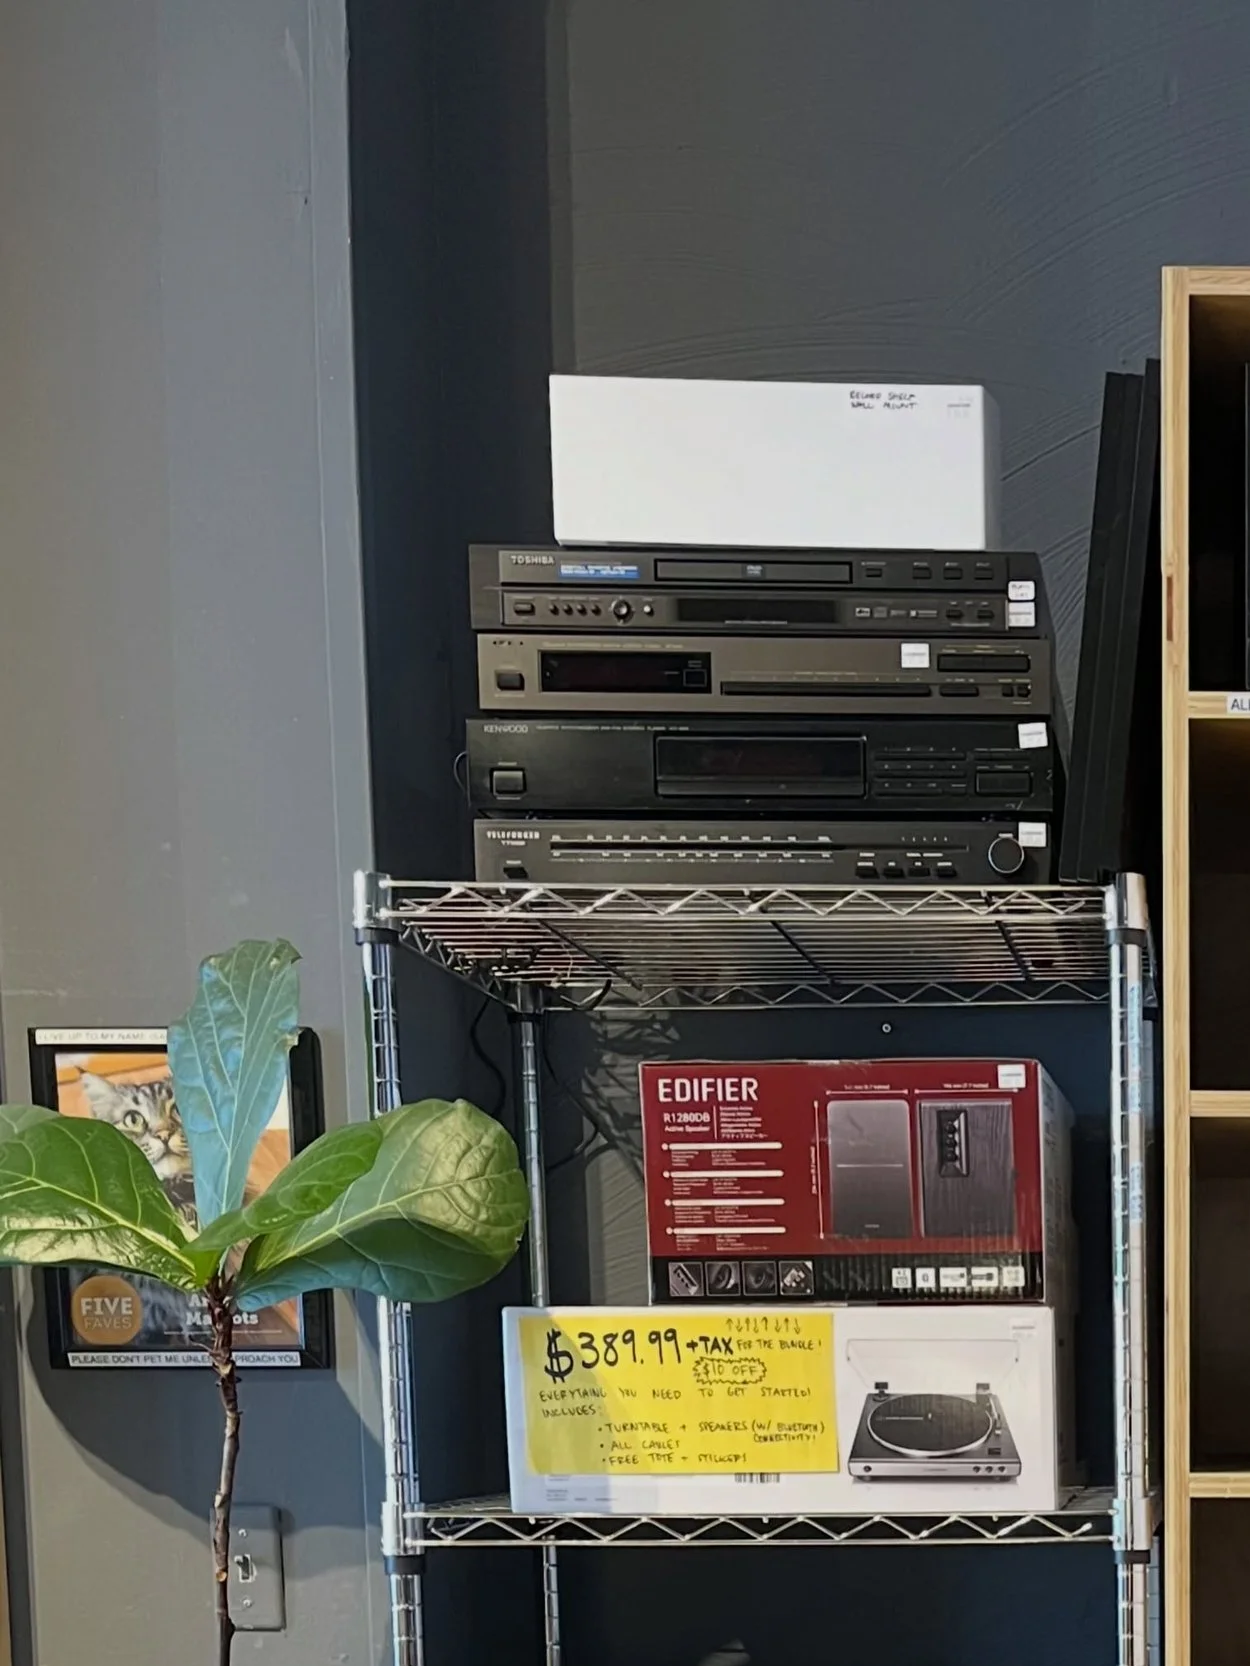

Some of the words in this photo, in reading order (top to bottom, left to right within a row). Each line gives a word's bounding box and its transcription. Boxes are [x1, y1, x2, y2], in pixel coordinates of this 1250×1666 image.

[510, 555, 555, 565] TOSHIBA
[483, 724, 528, 734] KENWOOD
[100, 1031, 115, 1041] MY
[117, 1031, 146, 1041] NAME
[658, 1077, 758, 1102] EDIFIER
[663, 1112, 710, 1123] R1280DB
[80, 1296, 133, 1315] FIVE
[83, 1317, 132, 1330] FAVES
[186, 1312, 259, 1325] Maots
[71, 1353, 110, 1364] PLEASE
[144, 1353, 164, 1364] PET
[165, 1353, 180, 1364] ME
[182, 1353, 213, 1364] UNLE
[278, 1353, 299, 1363] YOU
[544, 1328, 682, 1384] $389.99
[686, 1336, 733, 1356] +TAX
[702, 1362, 725, 1378] $10
[731, 1363, 759, 1377] OFF
[540, 1388, 607, 1402] EVERYTHING
[652, 1389, 682, 1400] NEED
[699, 1388, 714, 1398] TO
[727, 1387, 746, 1397] GET
[605, 1422, 669, 1434] TURNTABLE
[698, 1421, 748, 1433] SPEAKERS
[611, 1440, 632, 1450] ALL
[641, 1440, 681, 1450] CABLES
[609, 1454, 640, 1465] FREE
